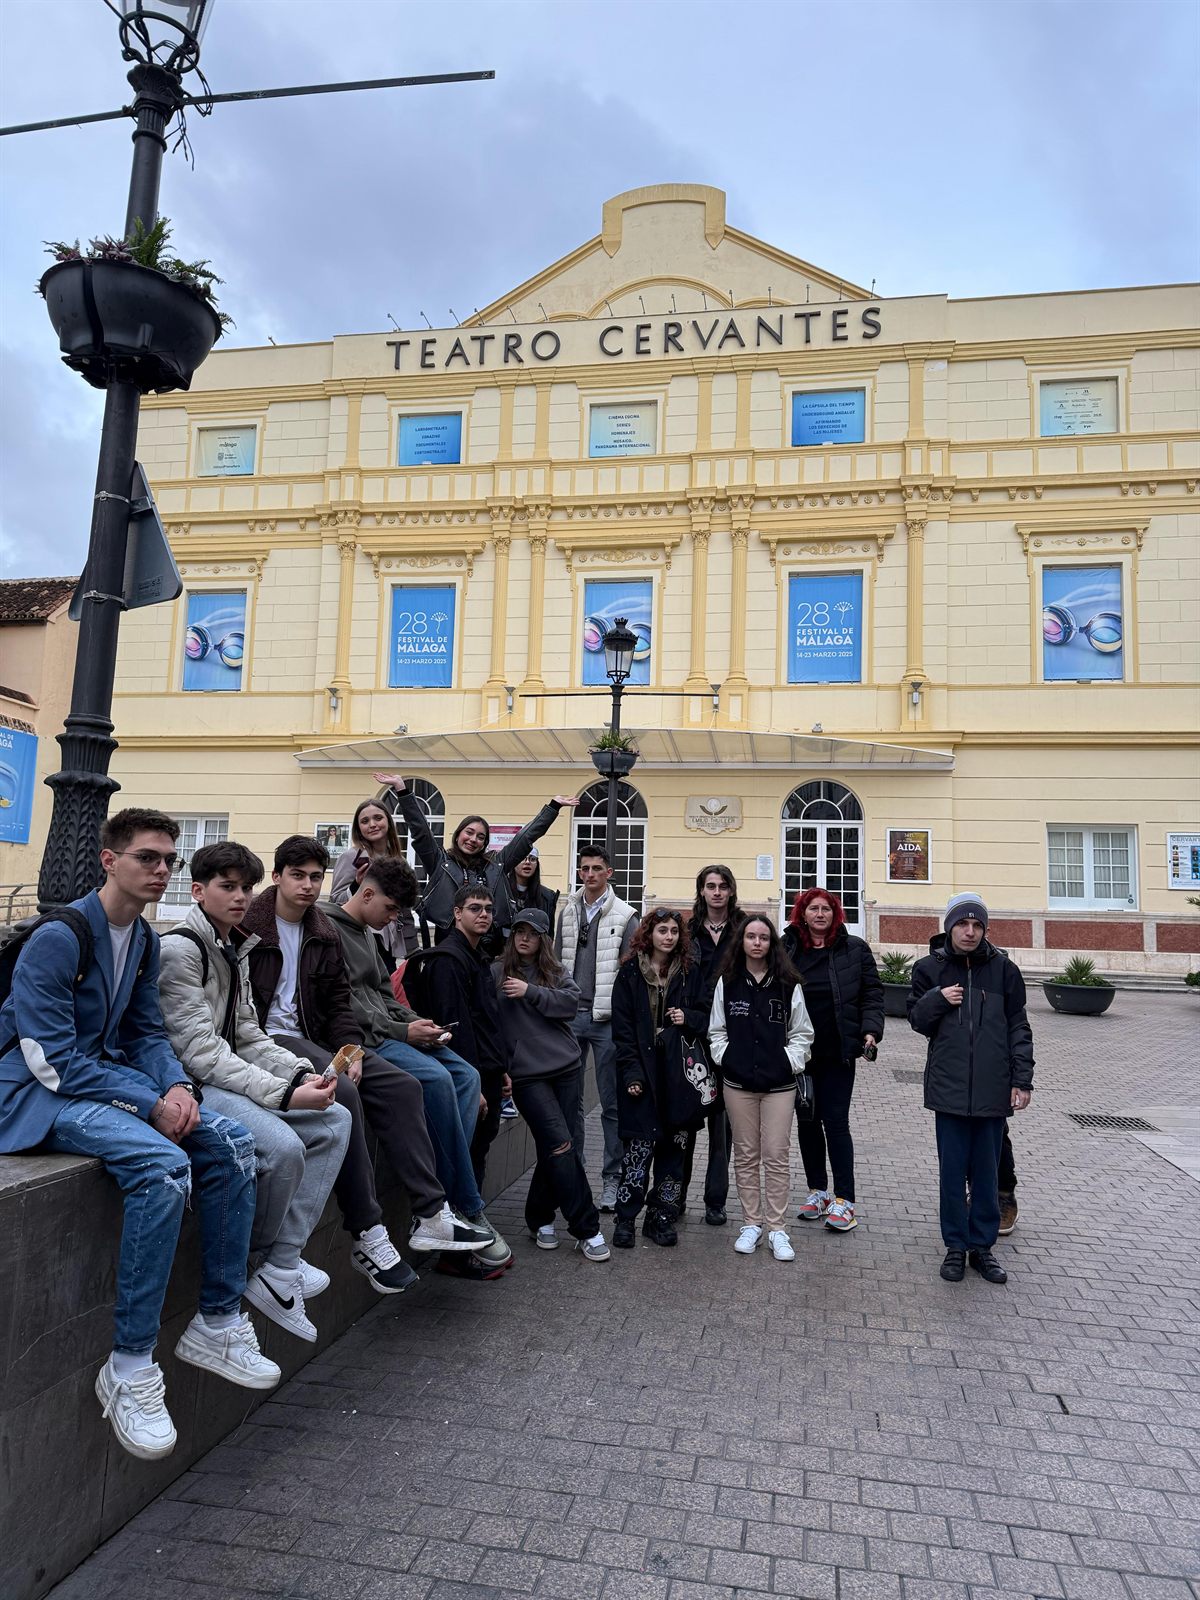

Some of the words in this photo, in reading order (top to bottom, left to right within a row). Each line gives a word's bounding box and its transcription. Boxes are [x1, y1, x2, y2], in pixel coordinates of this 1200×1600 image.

[386, 330, 561, 370] TEATRO
[599, 306, 882, 357] CERVANTES
[797, 602, 830, 626] 28
[399, 612, 427, 634] 28
[397, 642, 447, 653] MÁLAGA
[796, 635, 853, 646] MÁLAGA
[897, 843, 922, 852] AIDA
